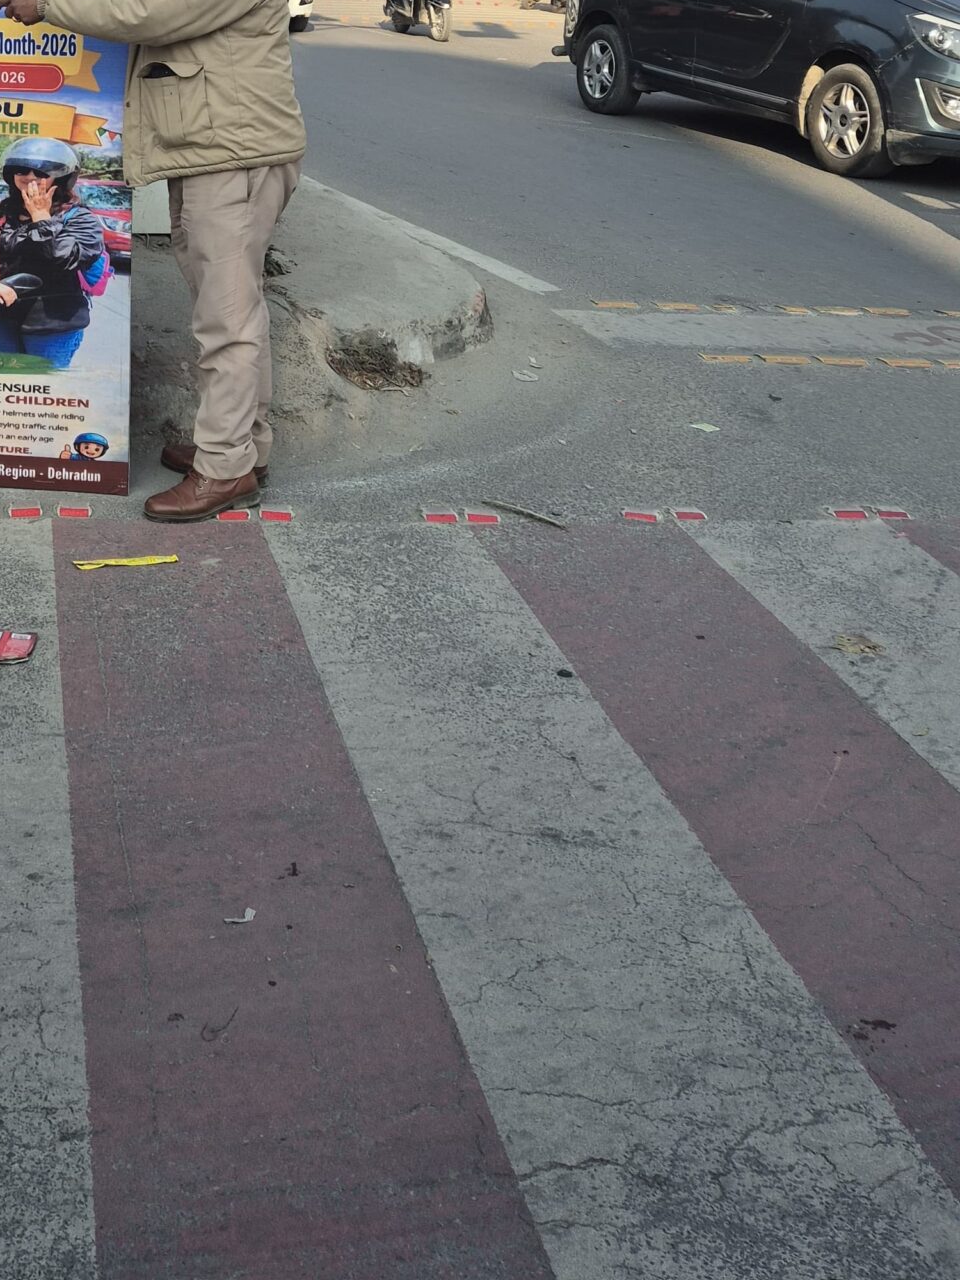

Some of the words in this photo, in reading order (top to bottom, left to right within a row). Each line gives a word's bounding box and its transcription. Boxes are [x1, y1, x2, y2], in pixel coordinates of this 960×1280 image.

[5, 394, 89, 409] CHILDREN
[2, 410, 36, 418] helmets
[61, 413, 85, 422] riding
[48, 467, 101, 482] Dehradun
